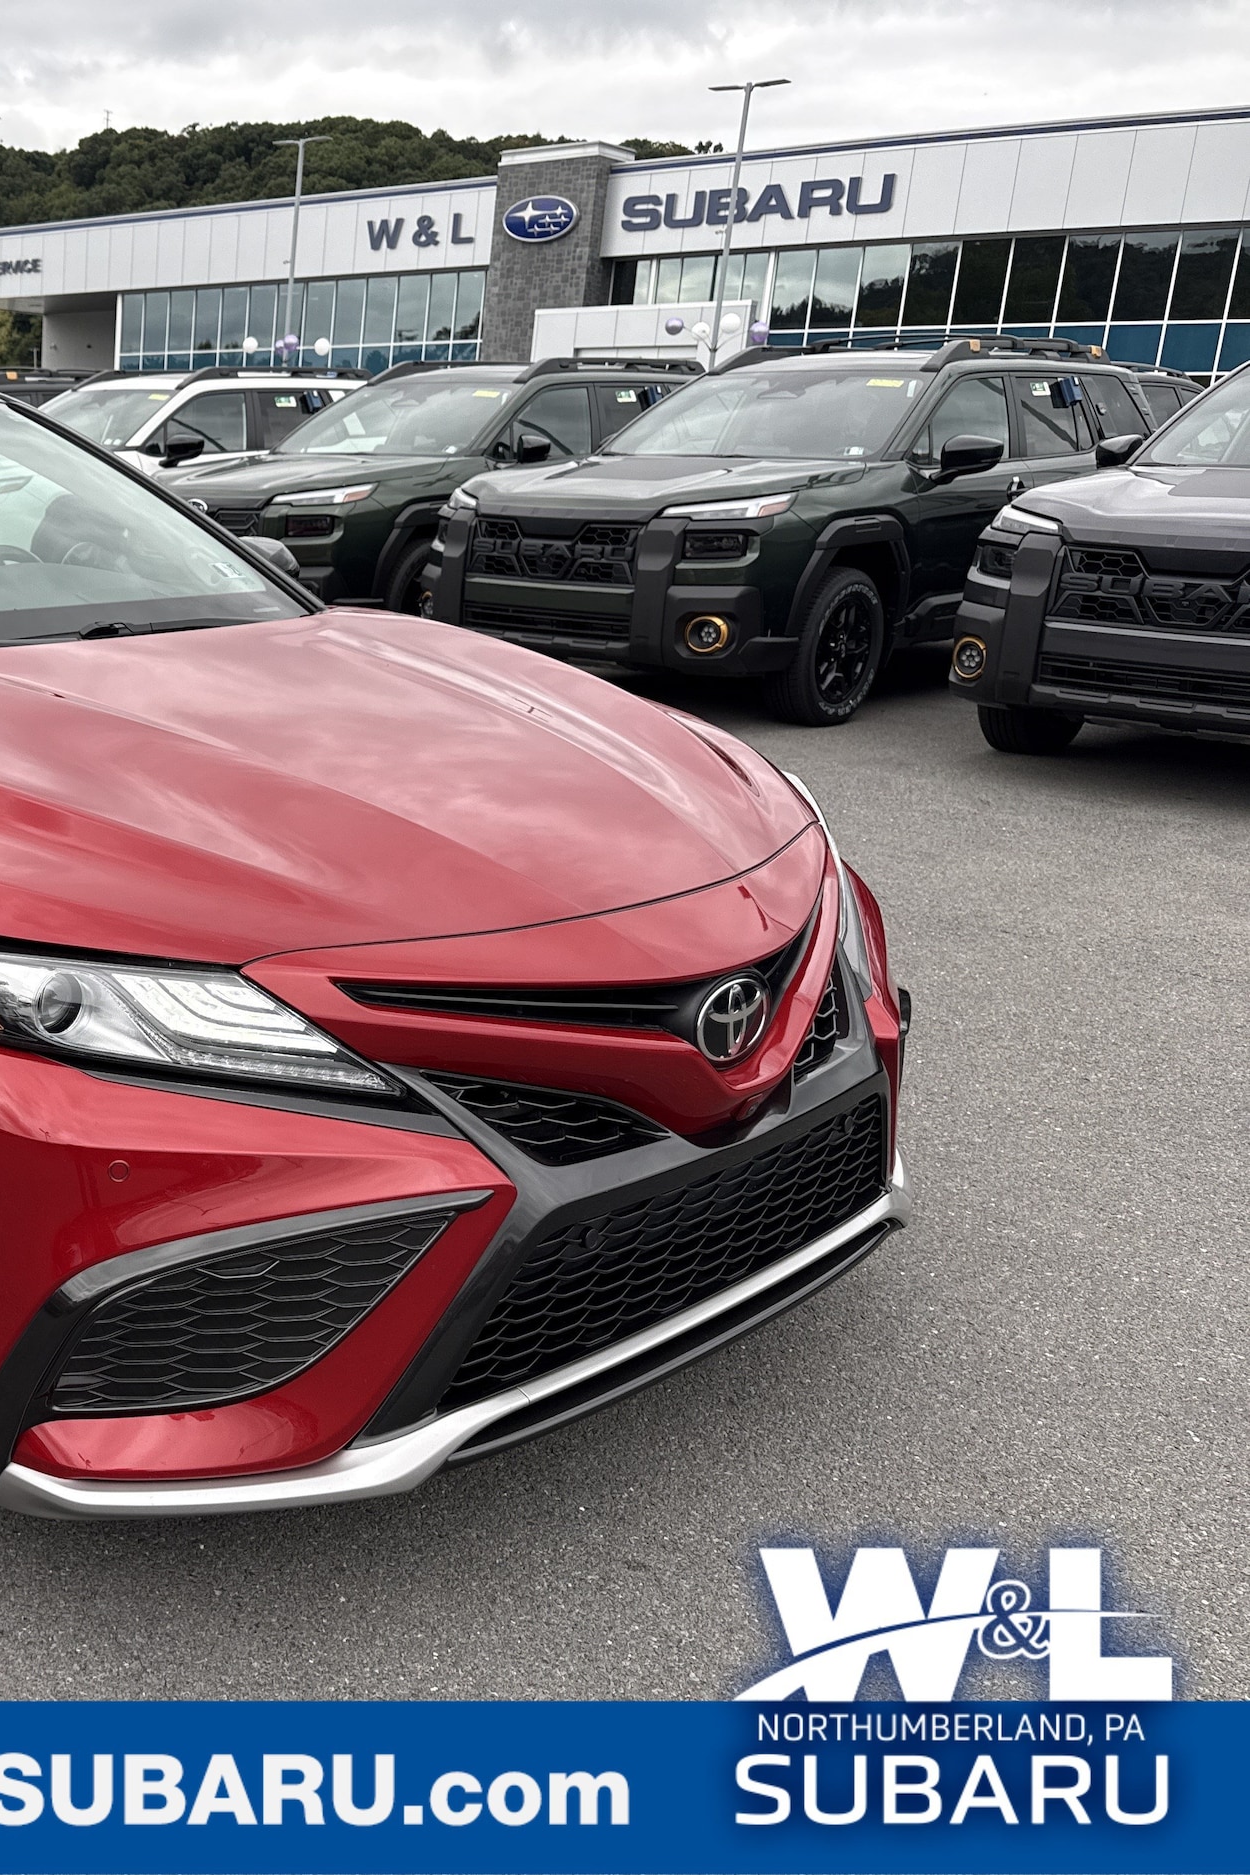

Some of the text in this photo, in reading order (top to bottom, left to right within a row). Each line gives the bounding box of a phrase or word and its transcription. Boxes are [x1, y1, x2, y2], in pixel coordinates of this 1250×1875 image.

[621, 172, 897, 233] SUBARU
[367, 212, 475, 251] W & L
[473, 537, 636, 563] SUBARU
[1059, 572, 1250, 604] SUBA
